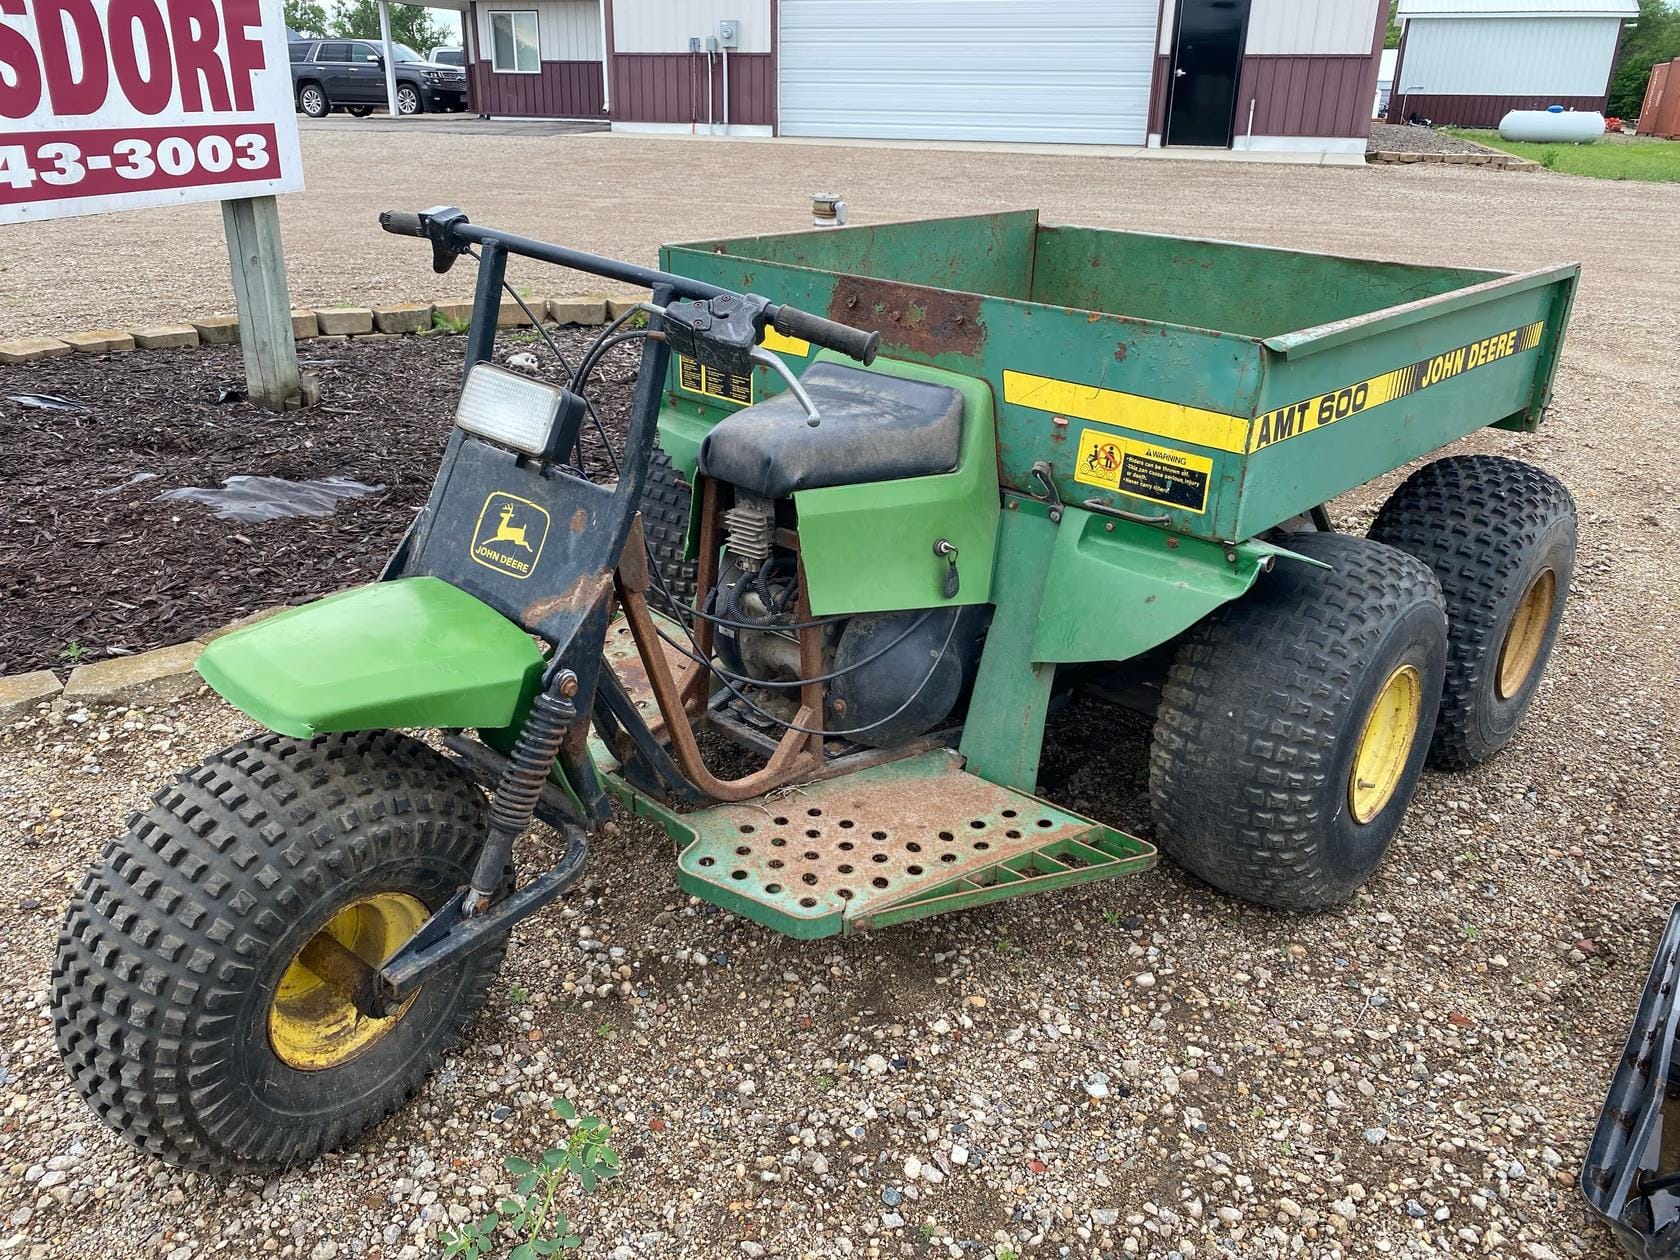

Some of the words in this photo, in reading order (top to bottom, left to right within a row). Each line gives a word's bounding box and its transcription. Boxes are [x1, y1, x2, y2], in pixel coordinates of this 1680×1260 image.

[1421, 347, 1466, 388] JOHN
[1467, 330, 1518, 370] DEERE
[1256, 400, 1310, 449] AMT
[1317, 382, 1369, 426] 600
[1152, 450, 1186, 465] WARNING
[475, 545, 500, 562] JOHN
[500, 554, 530, 573] DEERE
